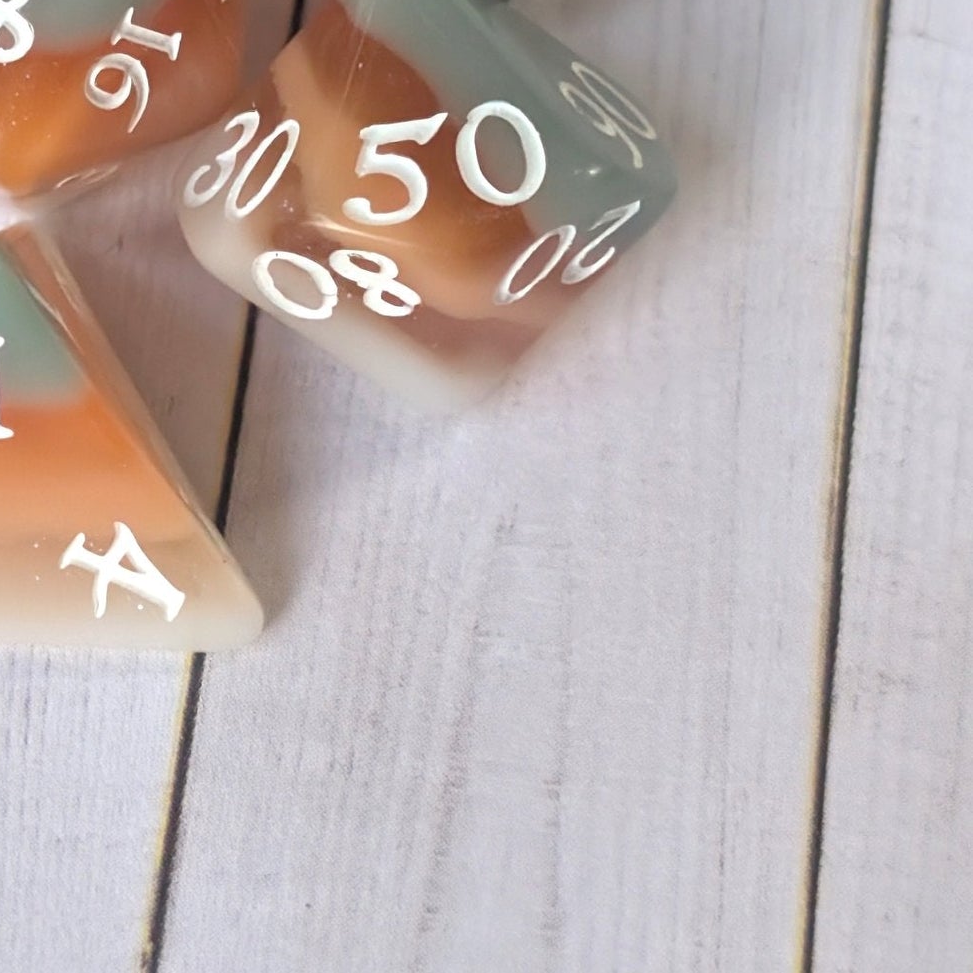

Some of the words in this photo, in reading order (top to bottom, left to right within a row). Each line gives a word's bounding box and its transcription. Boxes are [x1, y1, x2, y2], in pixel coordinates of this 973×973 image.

[83, 6, 183, 135] 16
[183, 109, 301, 220] 30
[341, 100, 547, 227] 50
[251, 248, 423, 321] 80
[493, 200, 642, 305] 20
[59, 521, 187, 623] 4
